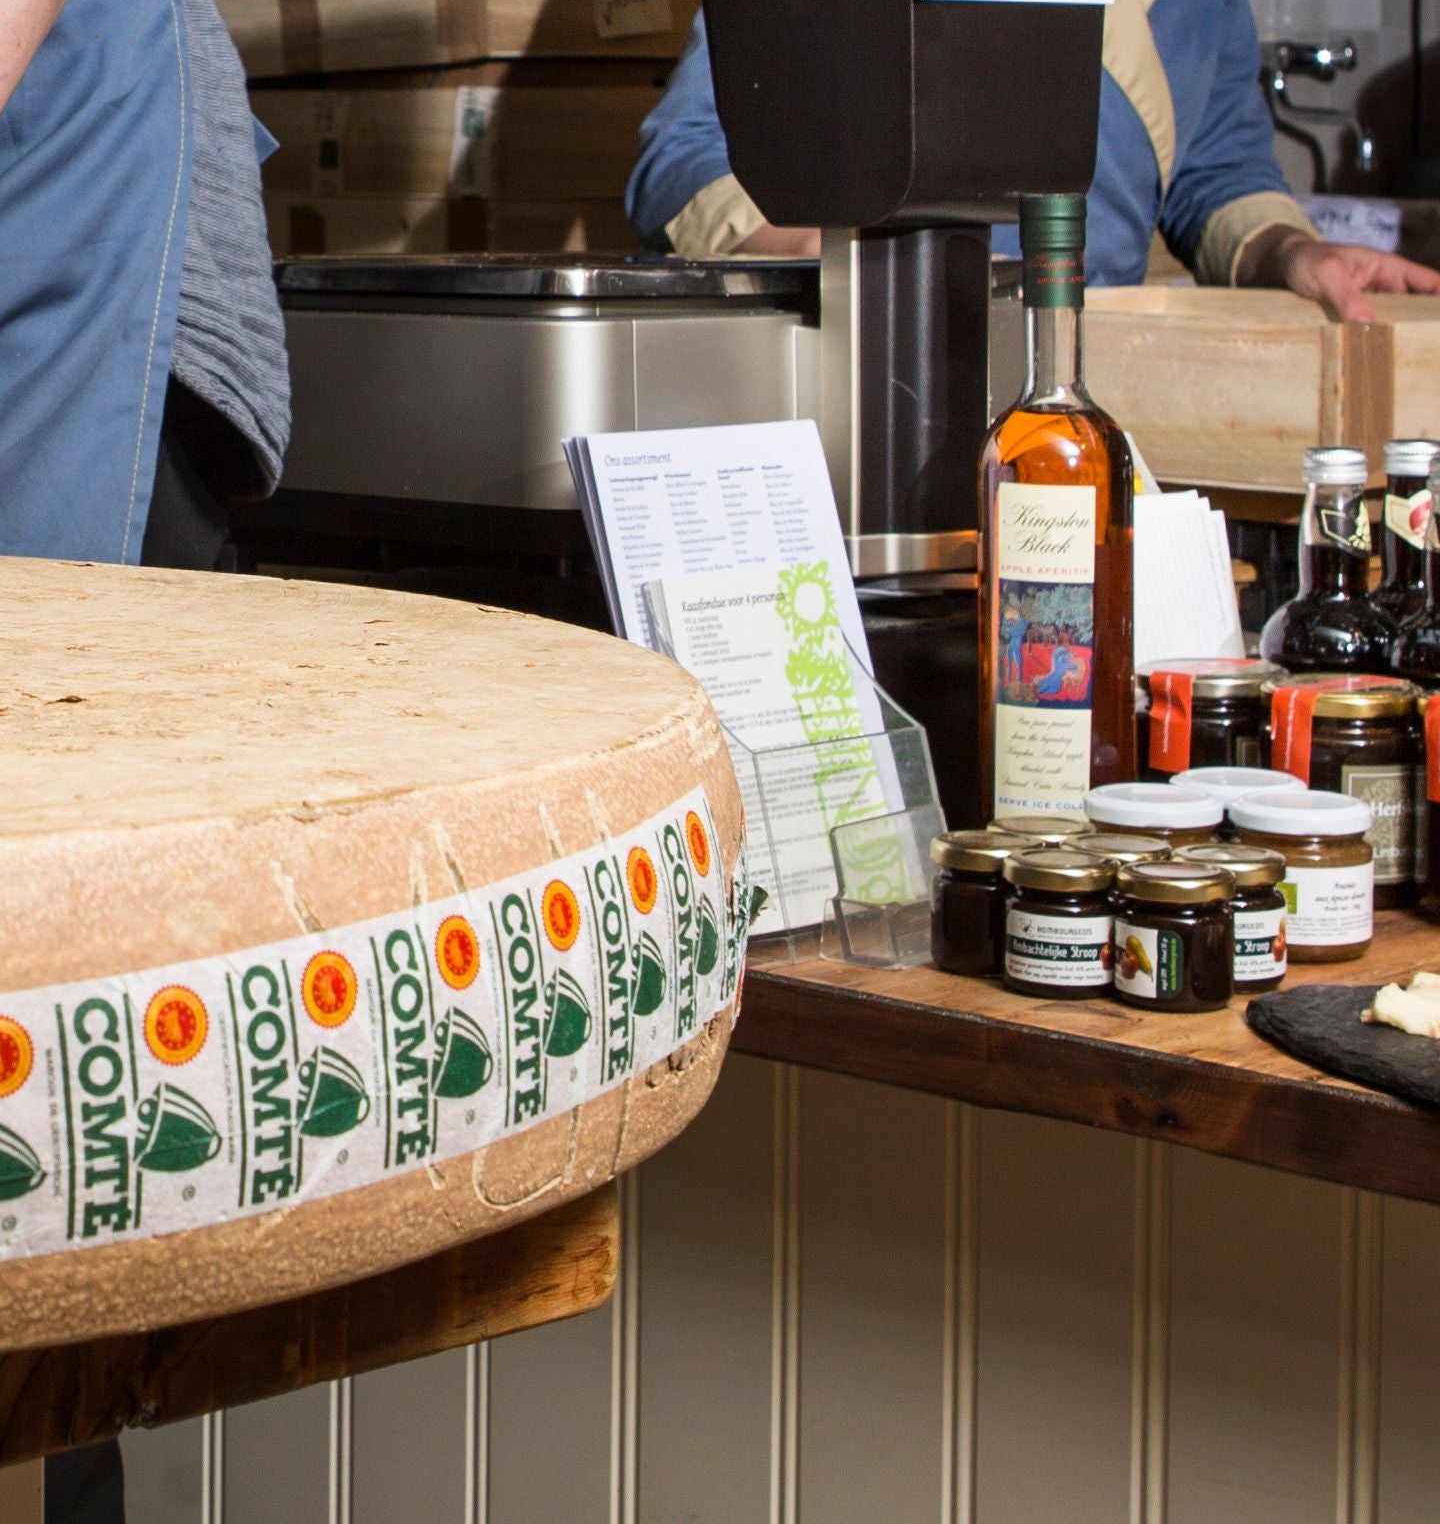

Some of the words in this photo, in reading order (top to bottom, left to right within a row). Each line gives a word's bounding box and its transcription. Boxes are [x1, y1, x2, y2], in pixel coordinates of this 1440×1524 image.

[604, 455, 621, 467] Ons
[623, 453, 672, 466] assortiment
[1003, 503, 1090, 537] Kingston
[1008, 529, 1075, 555] Black
[1001, 564, 1034, 574] APPLE
[1038, 566, 1090, 575] APERITIF
[681, 596, 726, 614] Kaasfondue
[727, 596, 745, 608] voor
[999, 796, 1028, 807] SERVE
[1033, 800, 1052, 809] ICE
[1071, 945, 1099, 960] Stroop
[1244, 940, 1270, 954] Stroop
